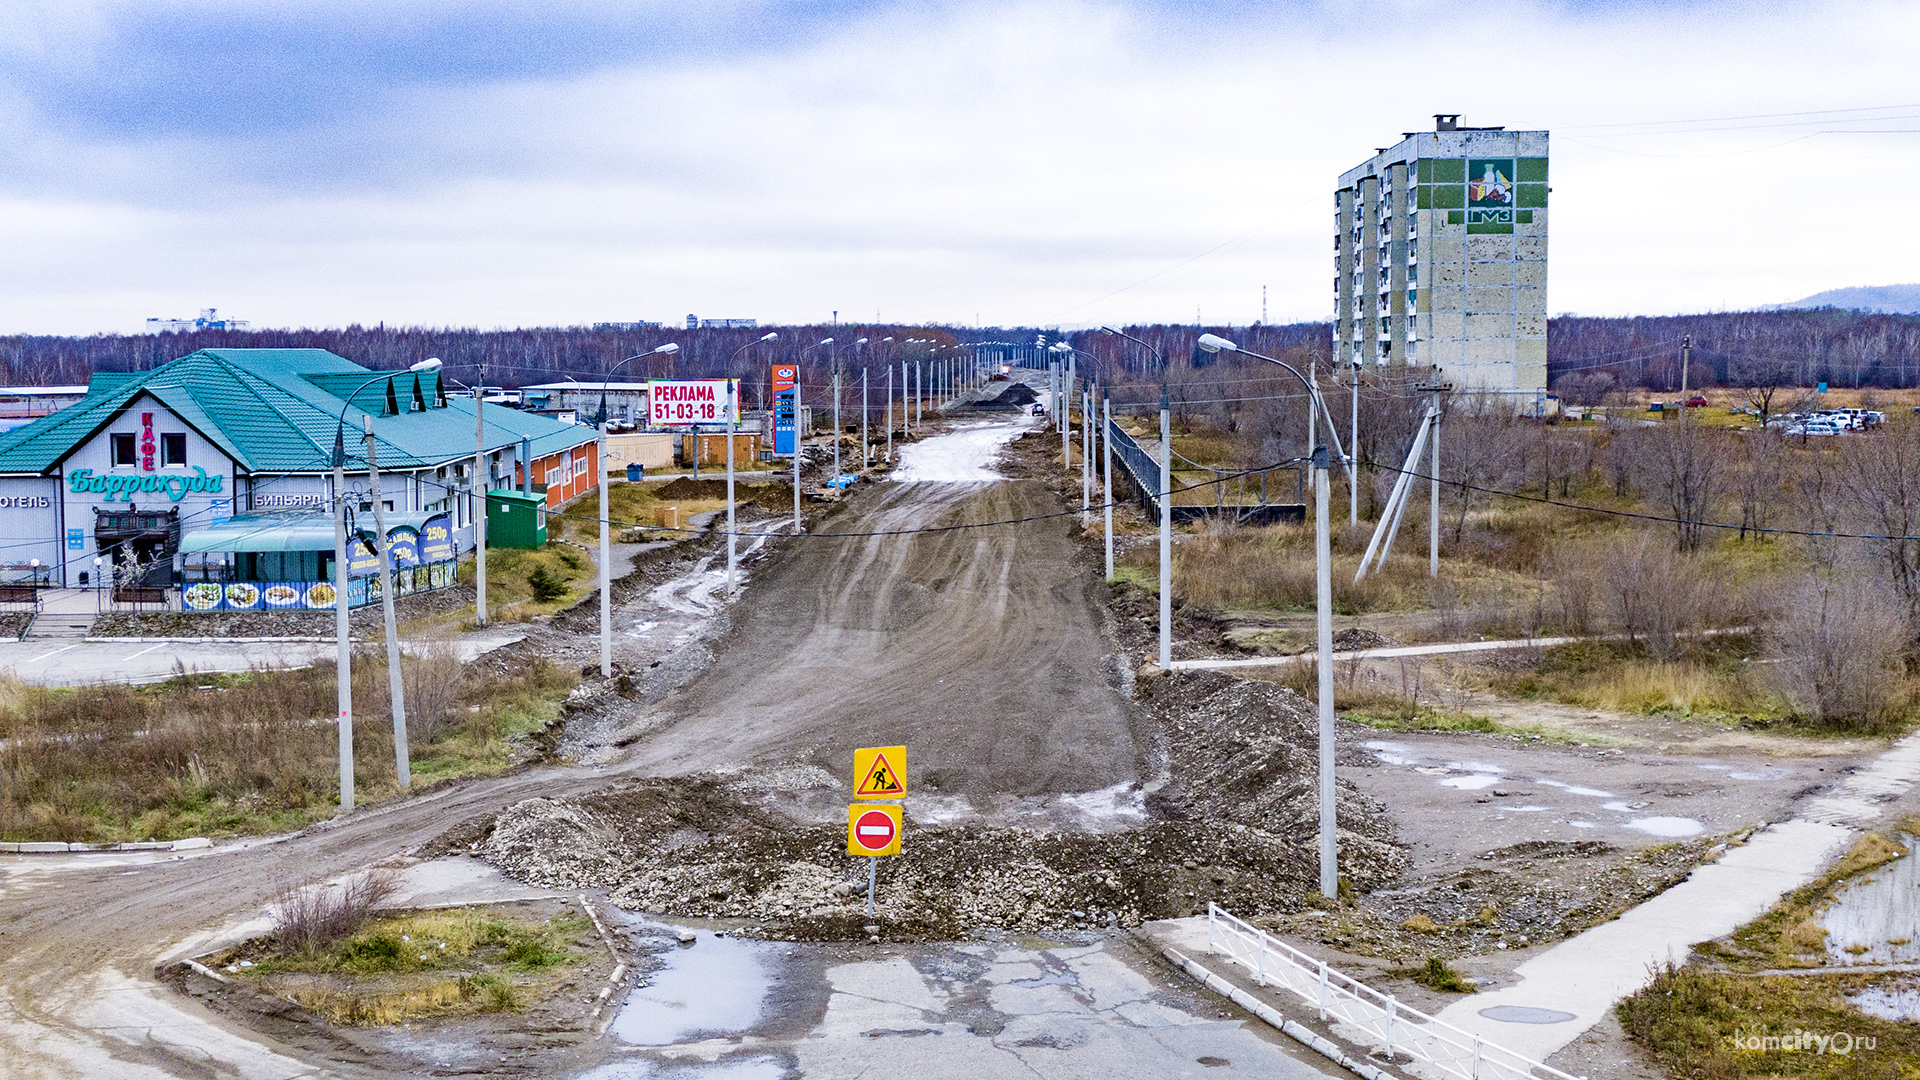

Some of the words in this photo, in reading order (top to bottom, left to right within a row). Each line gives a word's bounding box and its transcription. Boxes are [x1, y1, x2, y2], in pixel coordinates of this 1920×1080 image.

[655, 386, 715, 401] РЕКЛАМА
[655, 403, 715, 419] 51-03-18
[140, 412, 156, 471] КАФЕ
[66, 465, 223, 502] Барракуда
[0, 496, 49, 508] ОТЕЛЬ
[255, 494, 322, 508] БИЛЬЯРД
[427, 527, 447, 541] 250р
